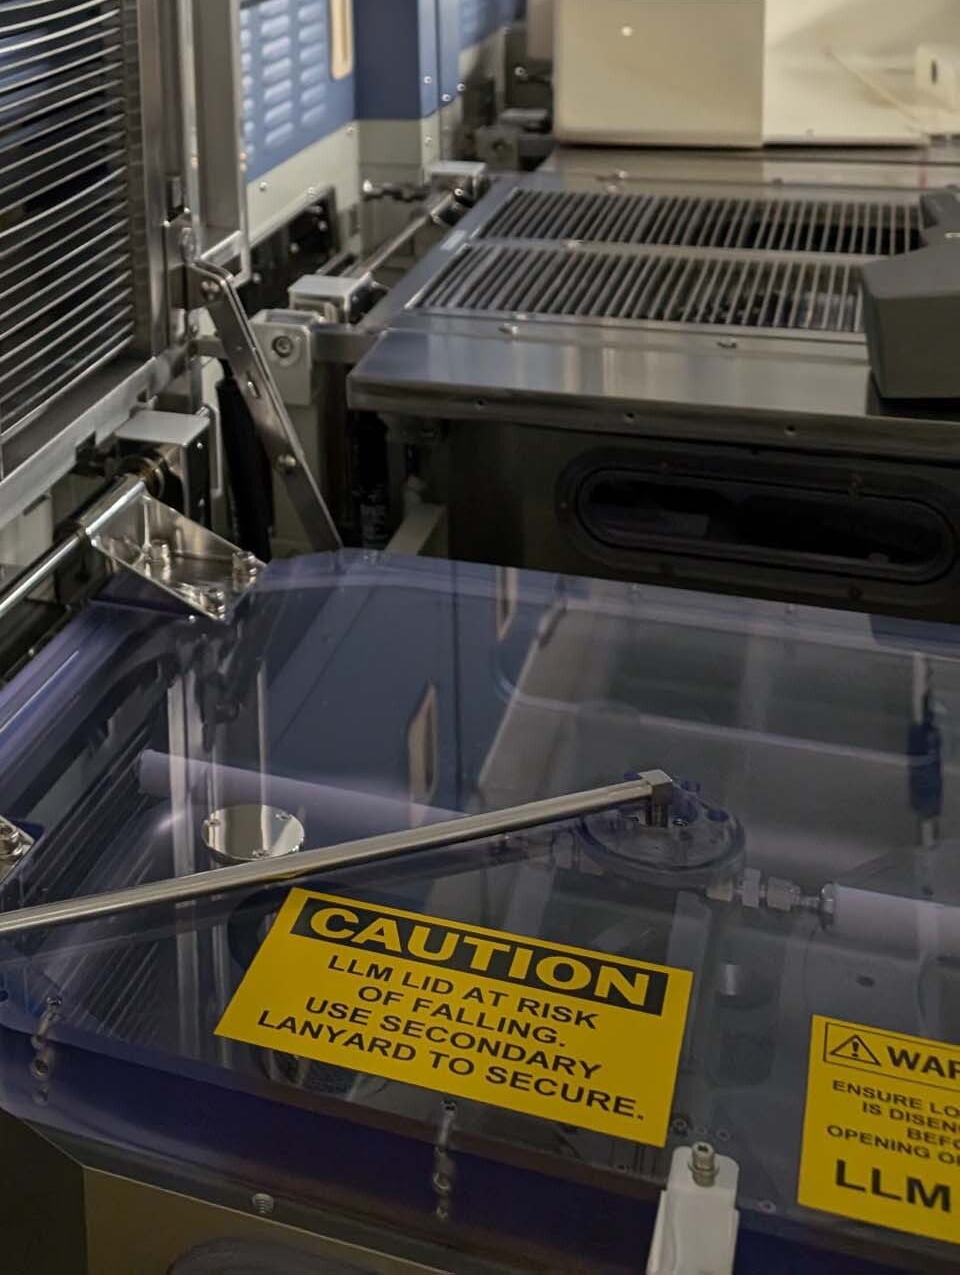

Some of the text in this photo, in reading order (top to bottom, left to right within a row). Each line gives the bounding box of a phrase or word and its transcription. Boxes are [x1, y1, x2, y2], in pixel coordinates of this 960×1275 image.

[310, 907, 650, 1006] CAUTION
[328, 955, 599, 1030] LLM LID AT RISK
[358, 986, 566, 1047] OF FALLING.
[257, 1010, 644, 1120] LANYARD TO SECURE.
[305, 996, 602, 1079] USE SECONDARY
[832, 1080, 923, 1110] ENSURE
[862, 1100, 960, 1134] IS DISEN
[826, 1124, 931, 1159] OPENING
[835, 1158, 951, 1213] LLM
